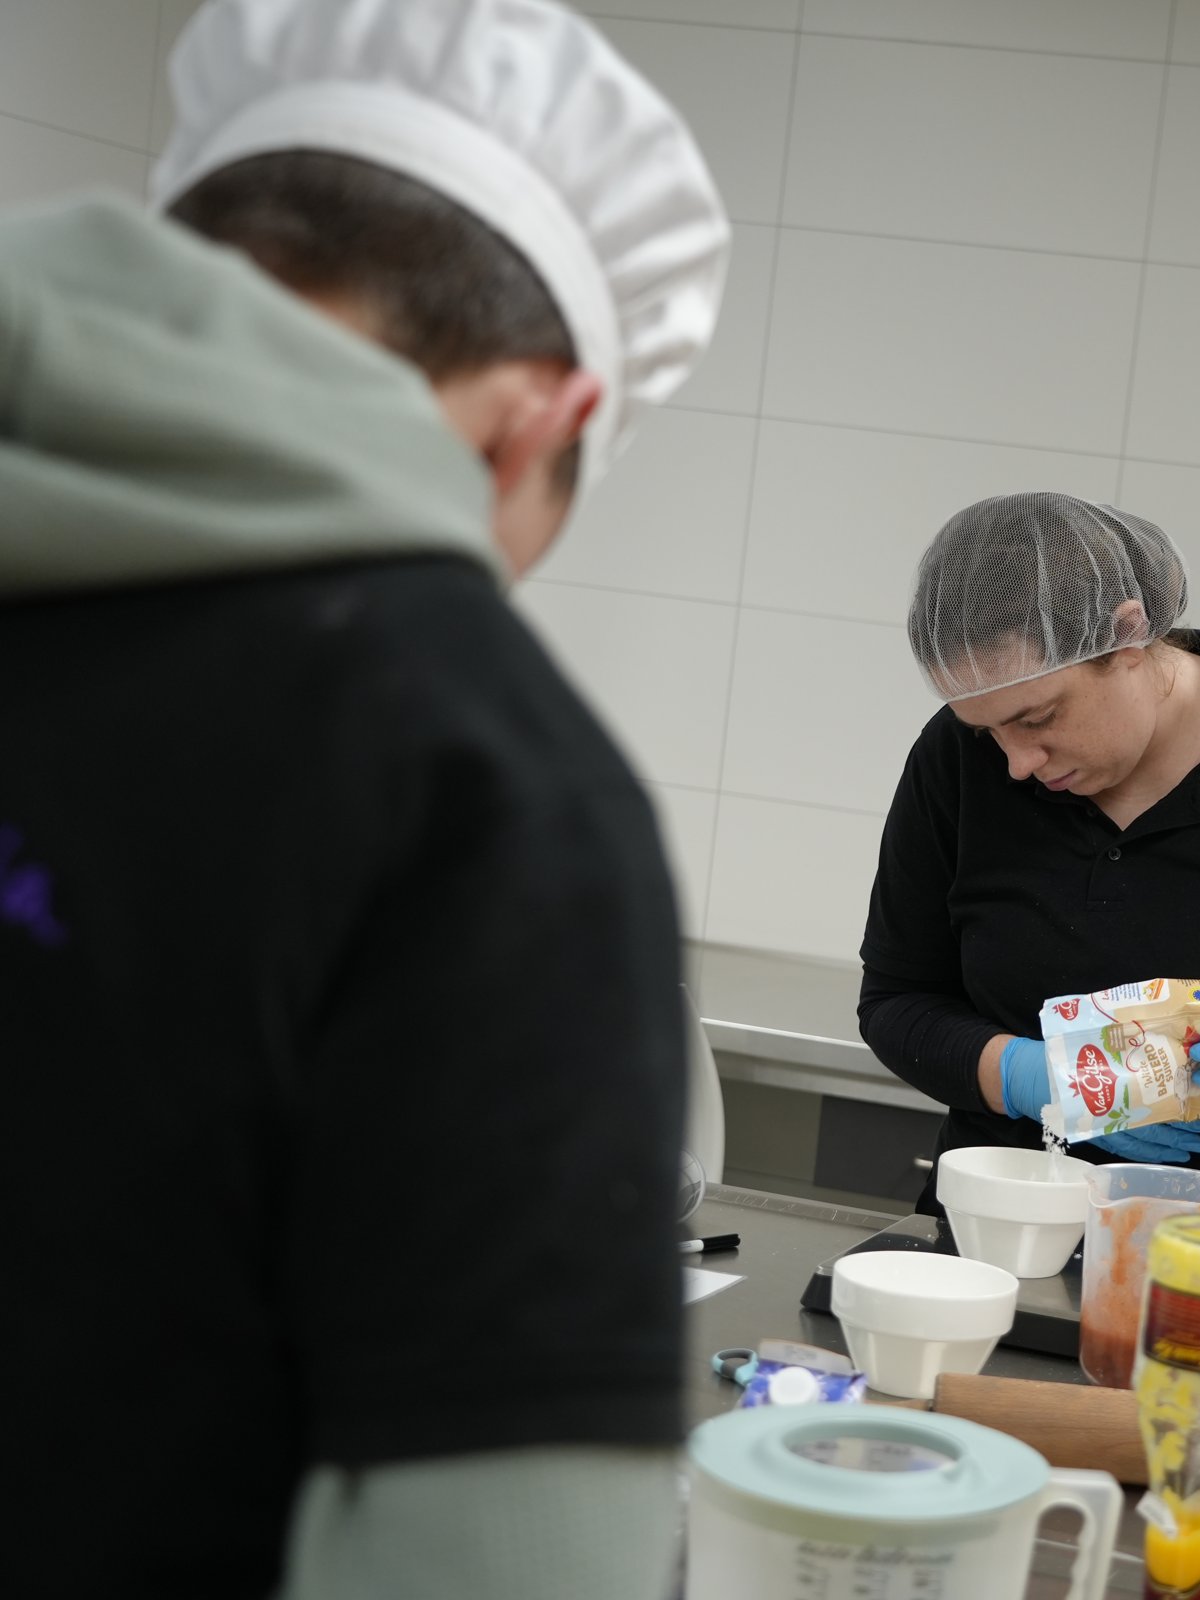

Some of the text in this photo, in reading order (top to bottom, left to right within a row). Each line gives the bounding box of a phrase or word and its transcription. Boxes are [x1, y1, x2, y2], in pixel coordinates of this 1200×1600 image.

[1082, 1049, 1112, 1114] Van Gilse
[1144, 1044, 1167, 1097] BASTERD
[1158, 1047, 1173, 1082] SUIKER
